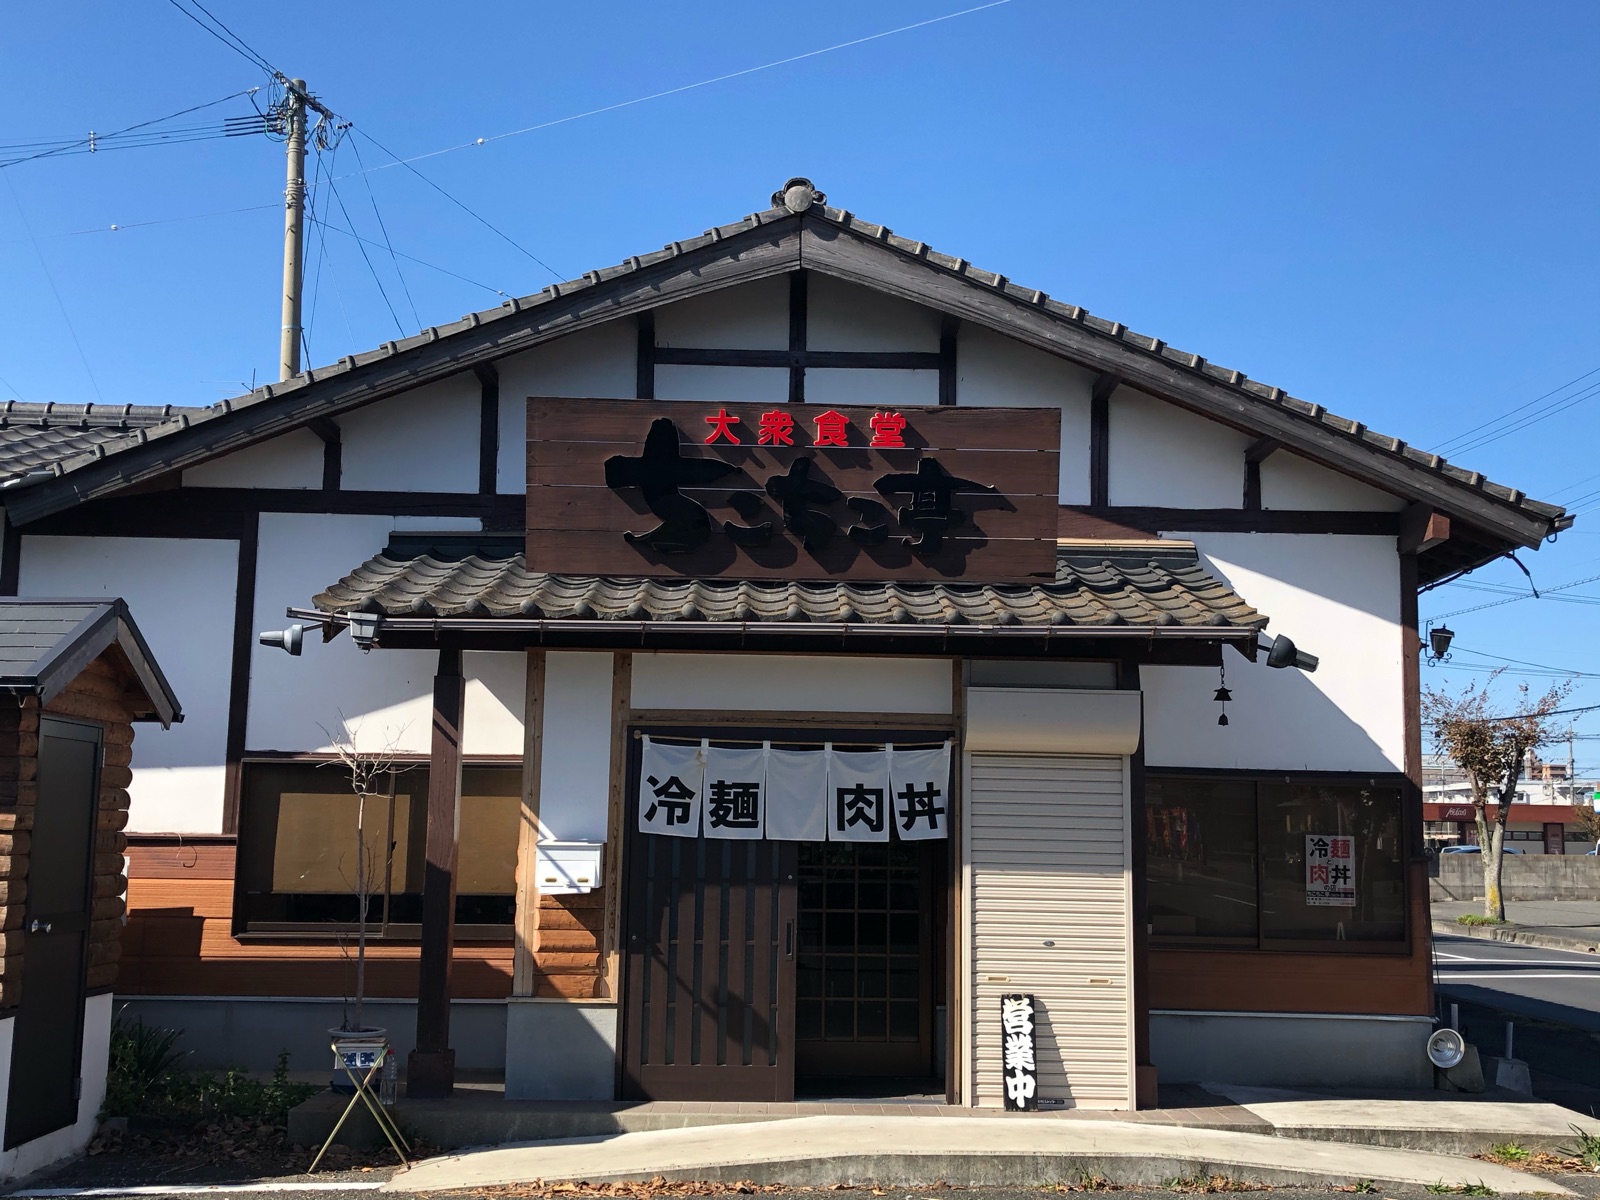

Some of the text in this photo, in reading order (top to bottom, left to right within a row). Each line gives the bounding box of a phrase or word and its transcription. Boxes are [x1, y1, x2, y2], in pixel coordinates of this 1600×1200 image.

[705, 410, 906, 448] 大衆食堂
[645, 776, 945, 832] 冷麺 肉丼
[1309, 837, 1351, 859] 冷麺
[1309, 864, 1352, 885] 肉丼
[1002, 998, 1036, 1108] 営業中
